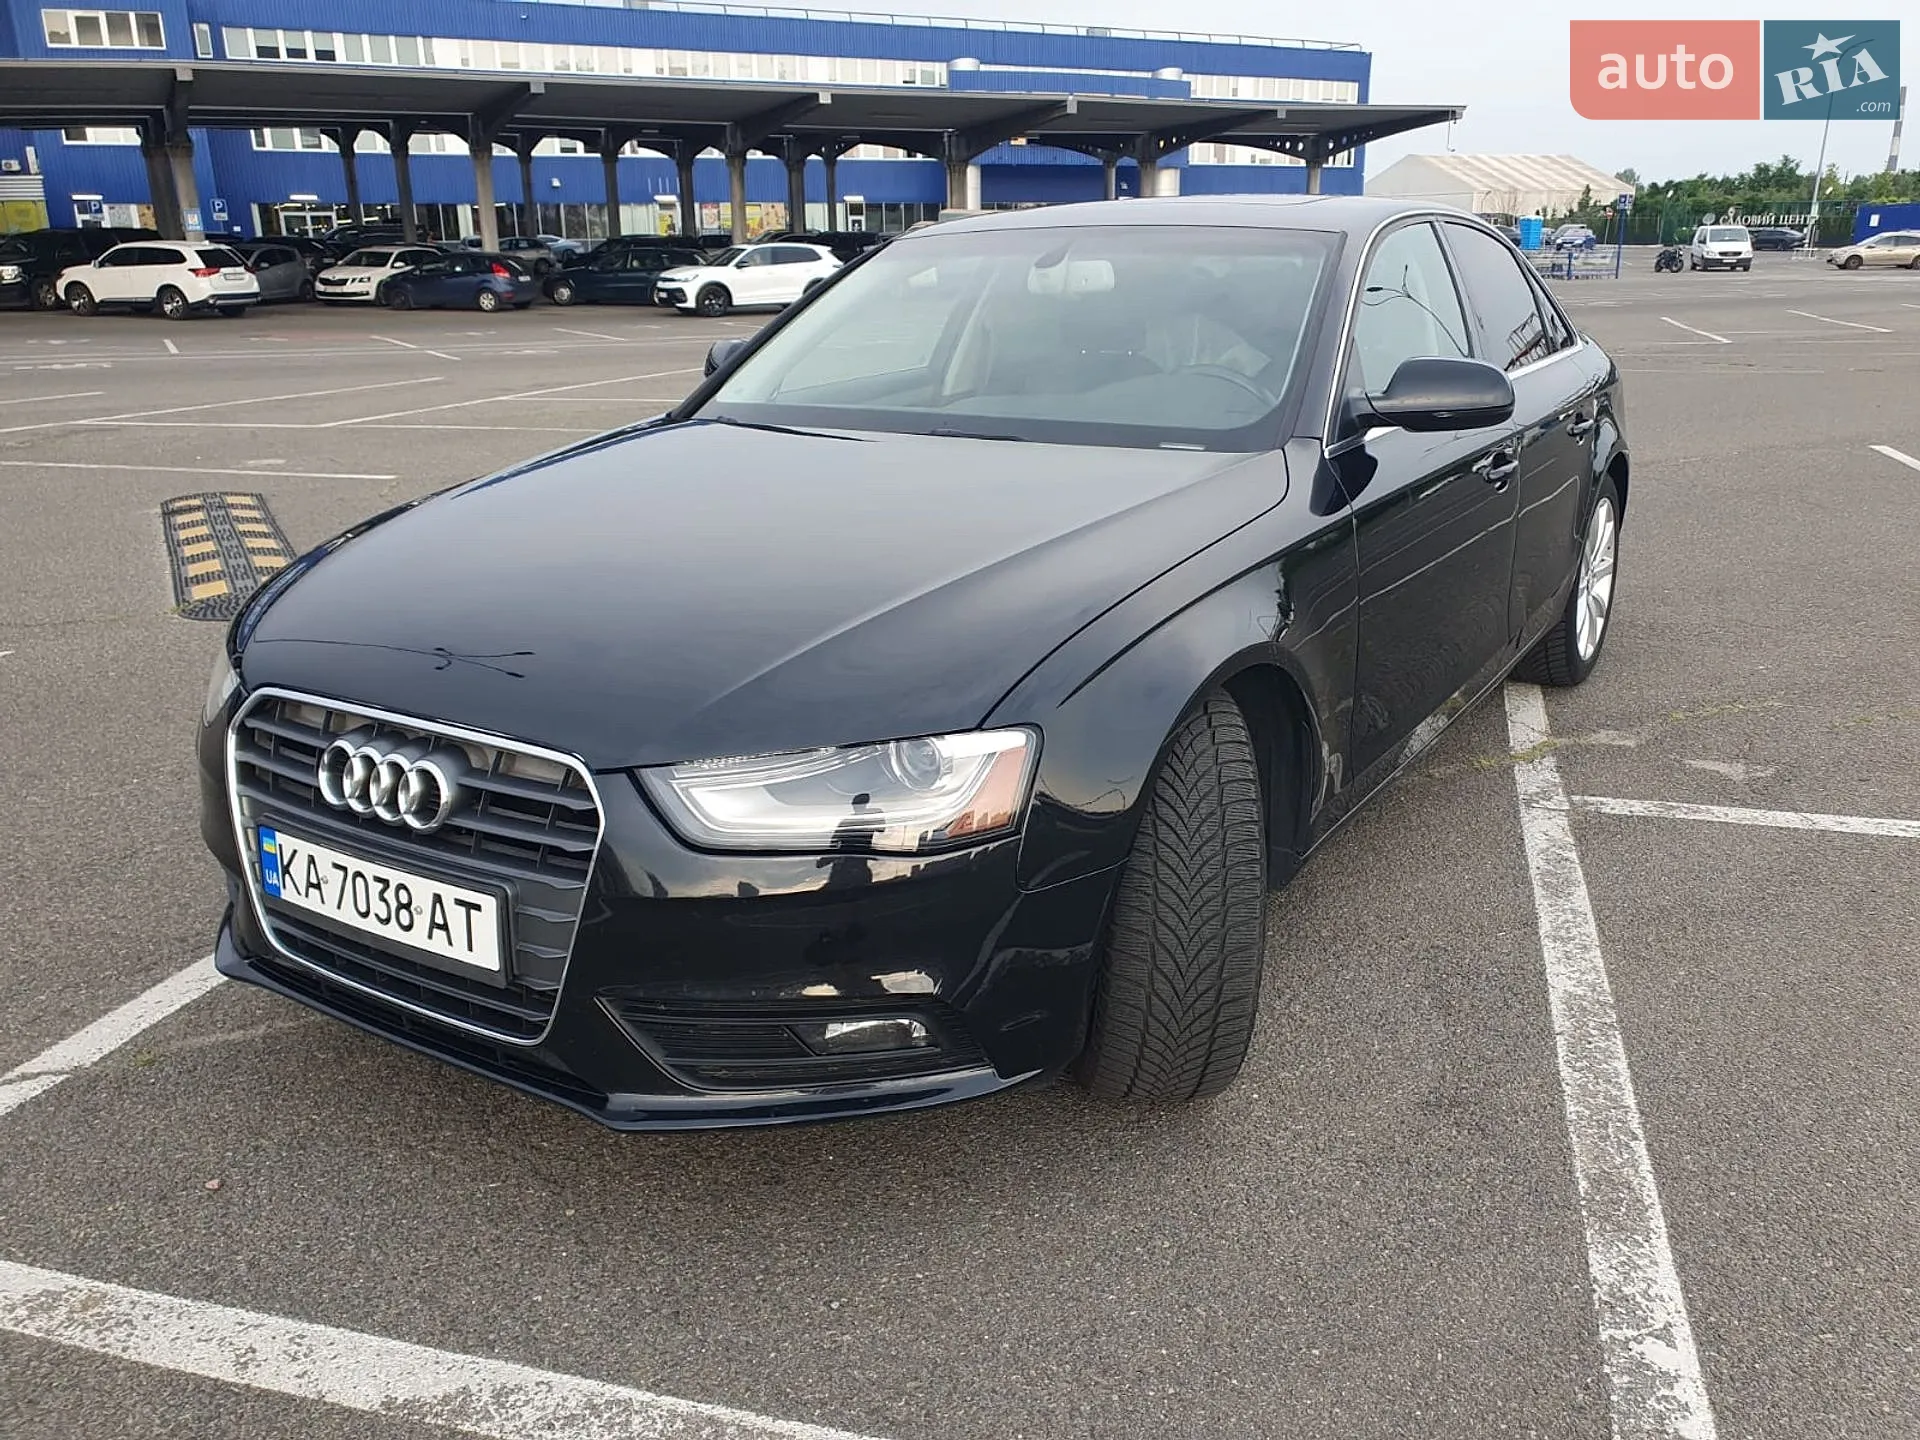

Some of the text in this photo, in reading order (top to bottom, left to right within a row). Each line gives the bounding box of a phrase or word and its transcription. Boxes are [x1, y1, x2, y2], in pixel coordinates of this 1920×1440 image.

[92, 202, 100, 212] P
[214, 201, 224, 212] P
[266, 867, 280, 888] UA
[278, 843, 483, 953] KA 7038 AT
